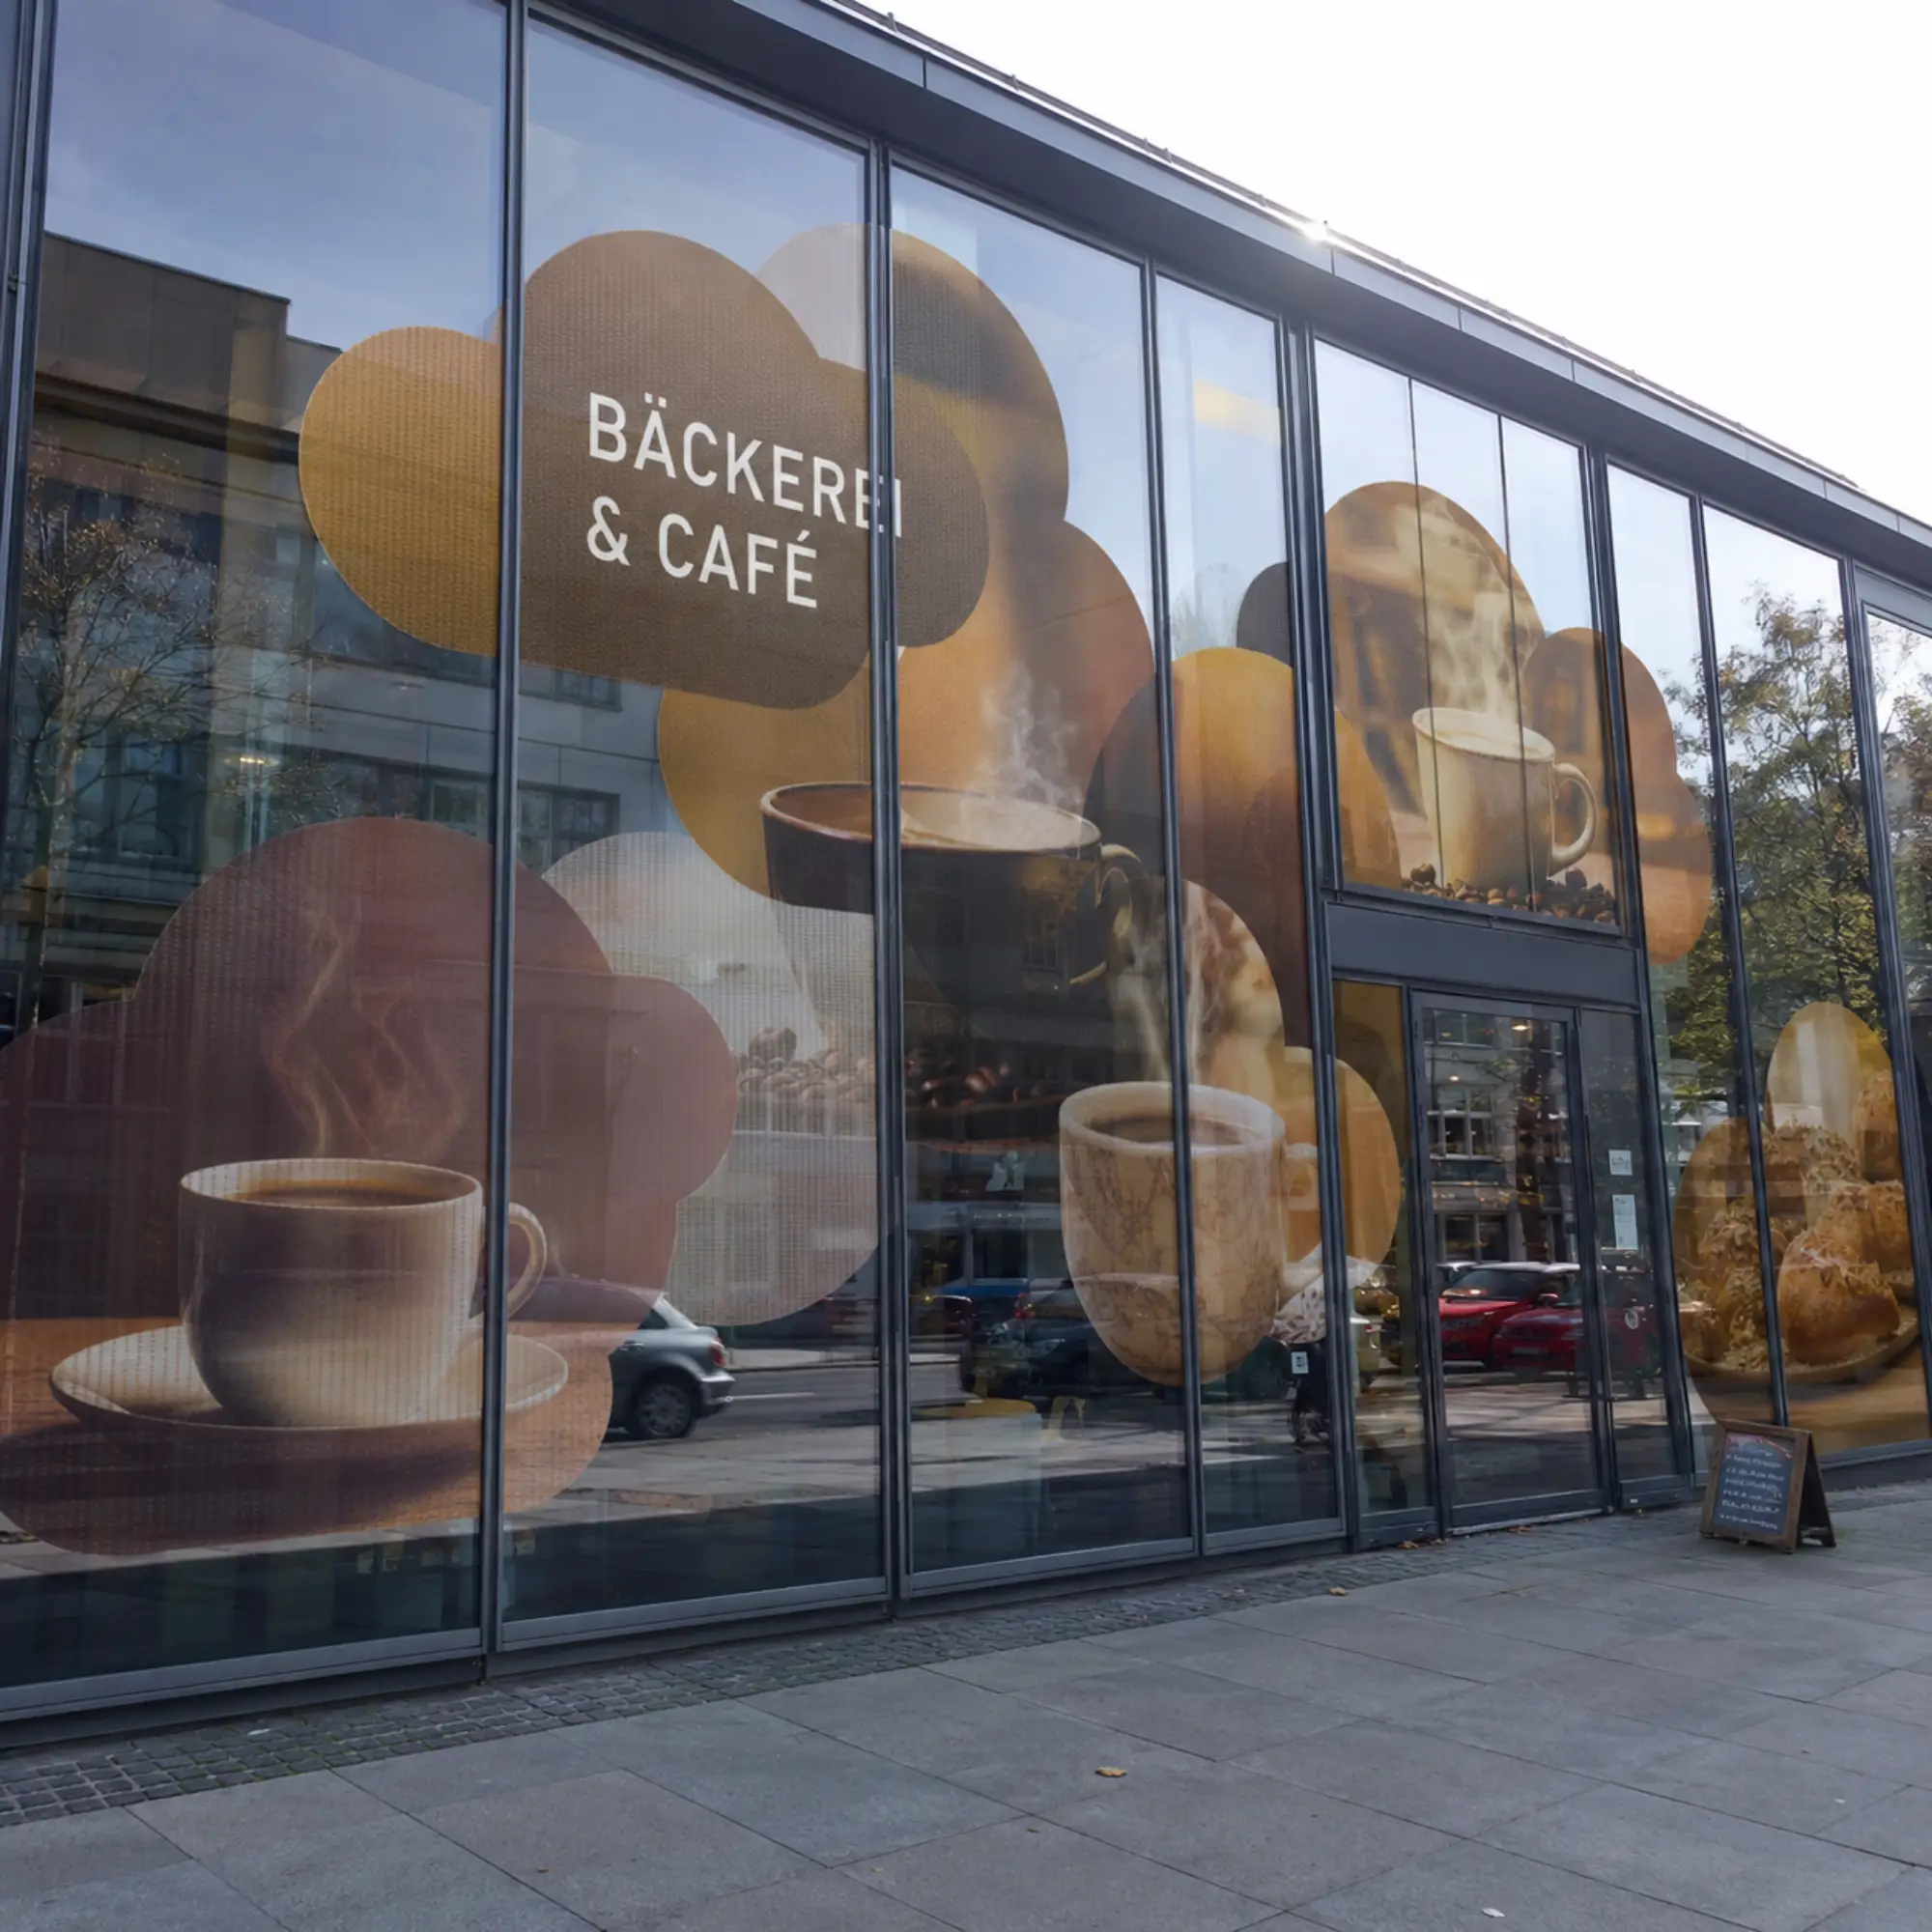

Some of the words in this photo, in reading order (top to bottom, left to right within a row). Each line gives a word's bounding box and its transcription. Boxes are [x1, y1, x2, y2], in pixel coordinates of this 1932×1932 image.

[589, 391, 901, 538] BÄCKEREI
[586, 496, 631, 566] &
[659, 513, 817, 609] CAFÉ
